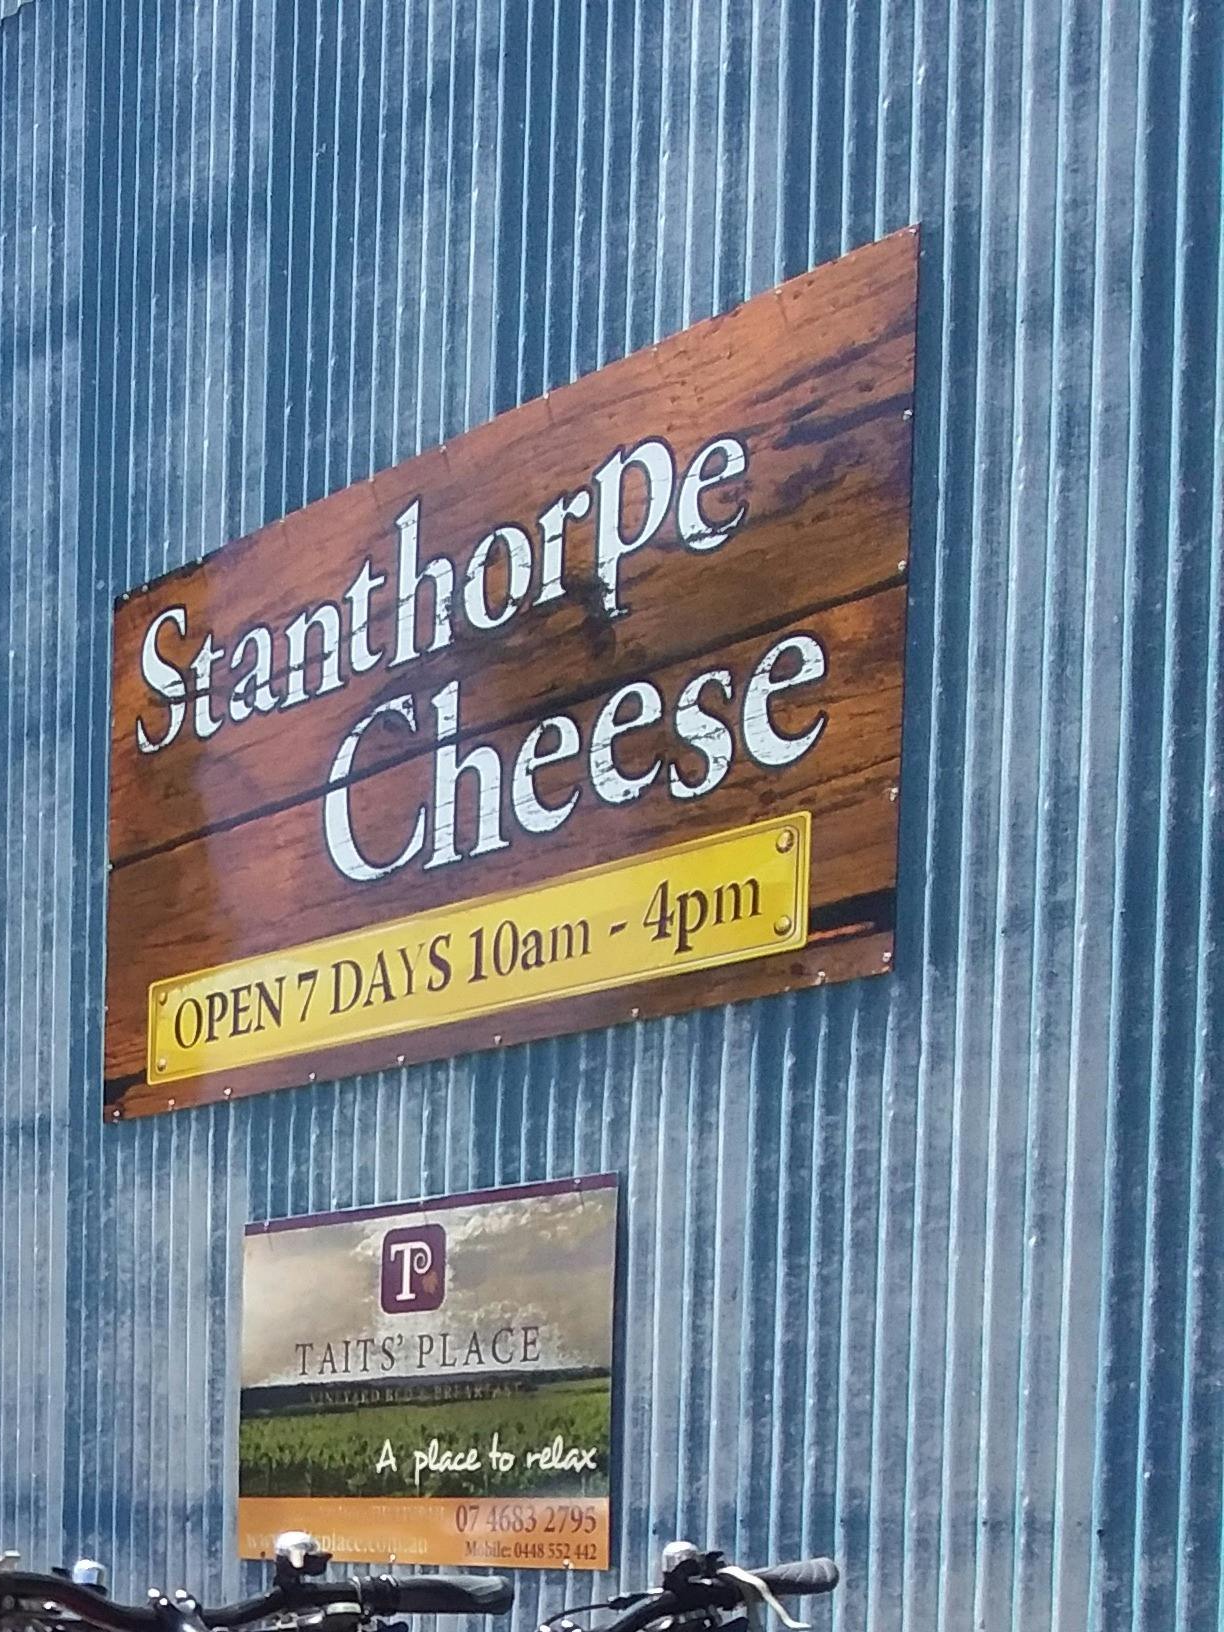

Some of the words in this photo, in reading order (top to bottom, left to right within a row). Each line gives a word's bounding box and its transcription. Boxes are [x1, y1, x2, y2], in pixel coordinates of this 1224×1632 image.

[136, 437, 749, 755] Stanthorpe
[325, 634, 827, 883] Cheese
[174, 975, 287, 1050] OPEN
[297, 968, 320, 1023] 7
[329, 933, 453, 1016] DAYS
[467, 918, 592, 984] 10am
[609, 921, 628, 937] -
[643, 876, 763, 955] 4pm
[295, 1333, 404, 1377] TAITS'
[417, 1326, 541, 1370] PLACE
[375, 1438, 397, 1474] A
[414, 1438, 481, 1485] place
[488, 1432, 514, 1473] to
[526, 1434, 598, 1473] relax
[455, 1504, 480, 1533] 07
[485, 1505, 537, 1533] 4683
[543, 1505, 597, 1534] 2795
[465, 1541, 512, 1559] Mobile:
[514, 1541, 544, 1559] 0448
[548, 1543, 571, 1560] 552
[574, 1543, 598, 1560] 442
